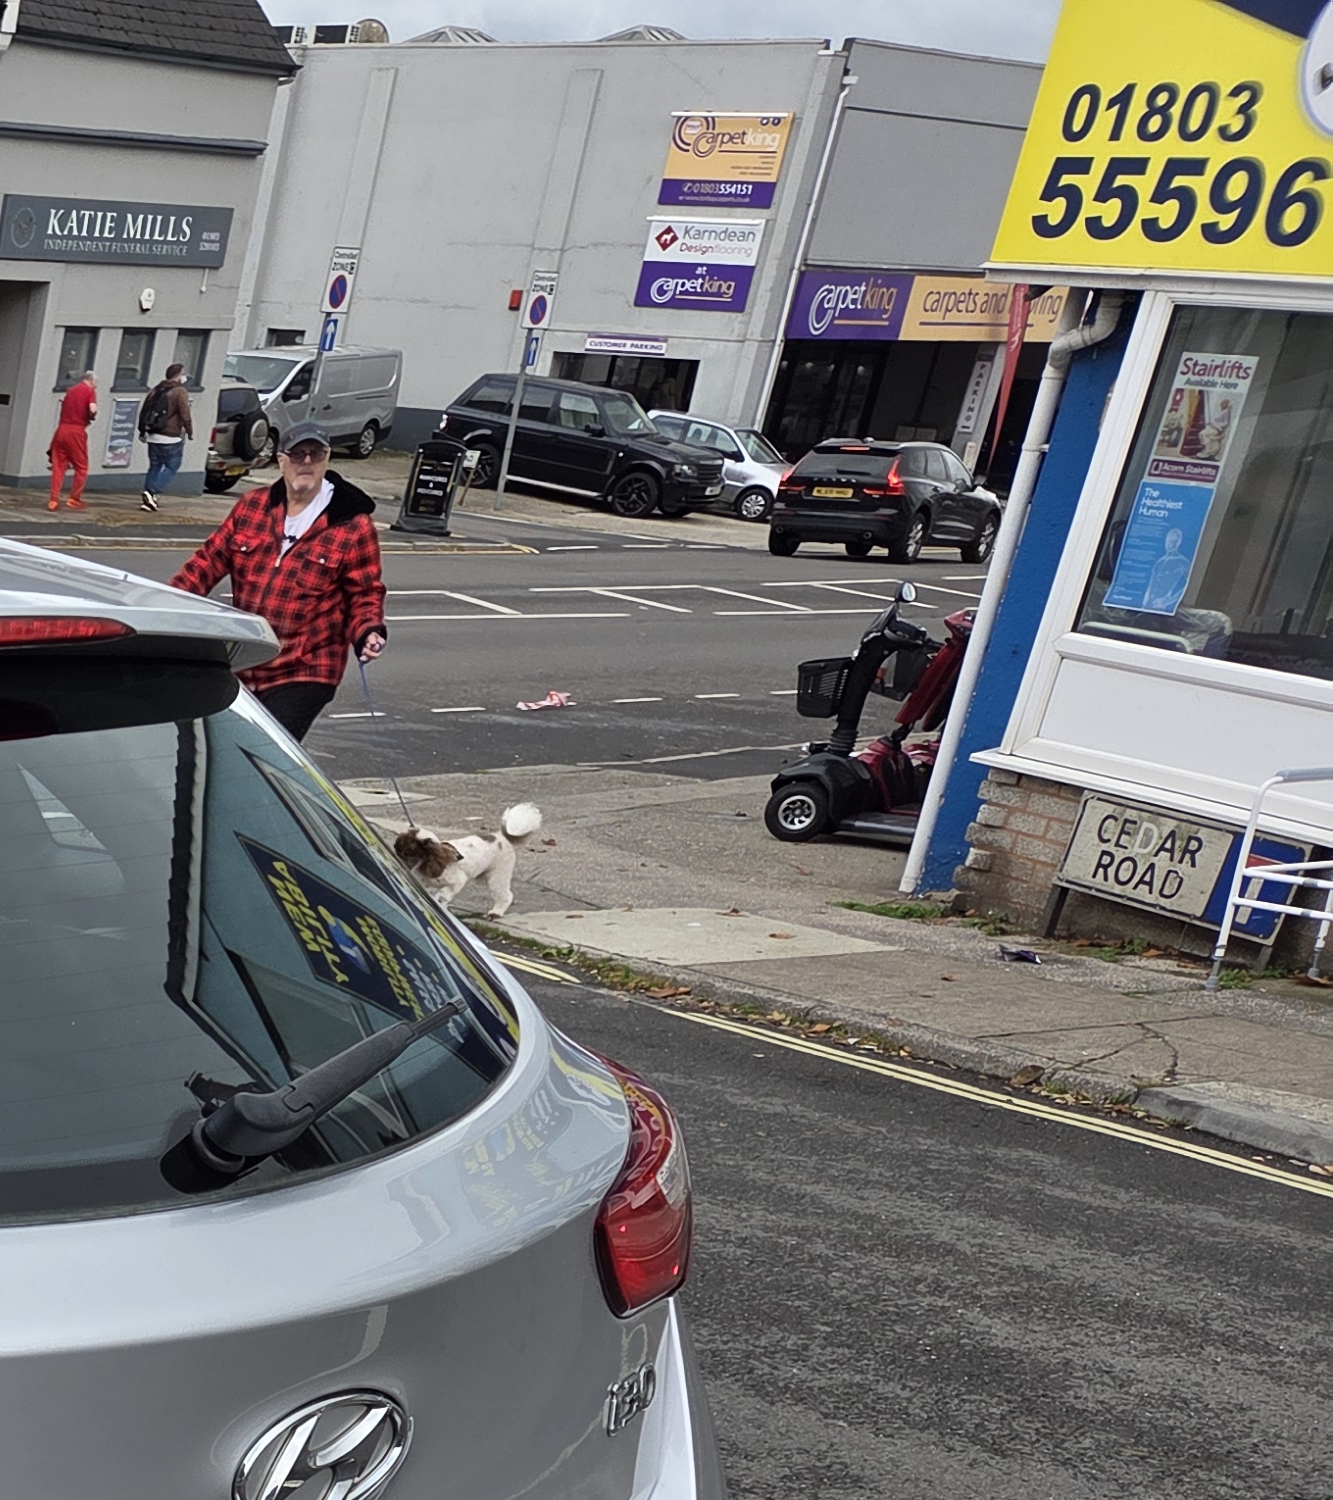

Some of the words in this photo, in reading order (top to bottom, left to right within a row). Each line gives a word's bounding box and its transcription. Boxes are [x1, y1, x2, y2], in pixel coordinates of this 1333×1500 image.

[1062, 80, 1264, 142] 01803
[47, 209, 117, 238] KATIE
[123, 213, 193, 242] MILLS
[683, 226, 756, 243] Karndean
[44, 239, 111, 253] INDEPENDENT
[112, 242, 150, 254] FUNERAL
[152, 244, 188, 256] SERVICE
[696, 266, 707, 275] at
[922, 287, 979, 321] carpets
[980, 286, 1010, 314] and
[589, 340, 627, 348] CUSTOMER
[630, 342, 663, 350] PARKING
[1180, 357, 1252, 380] Stairlifts
[1184, 377, 1218, 388] Available
[1138, 506, 1168, 518] Human
[1097, 814, 1203, 868] CEDAR
[1092, 850, 1183, 899] ROAD
